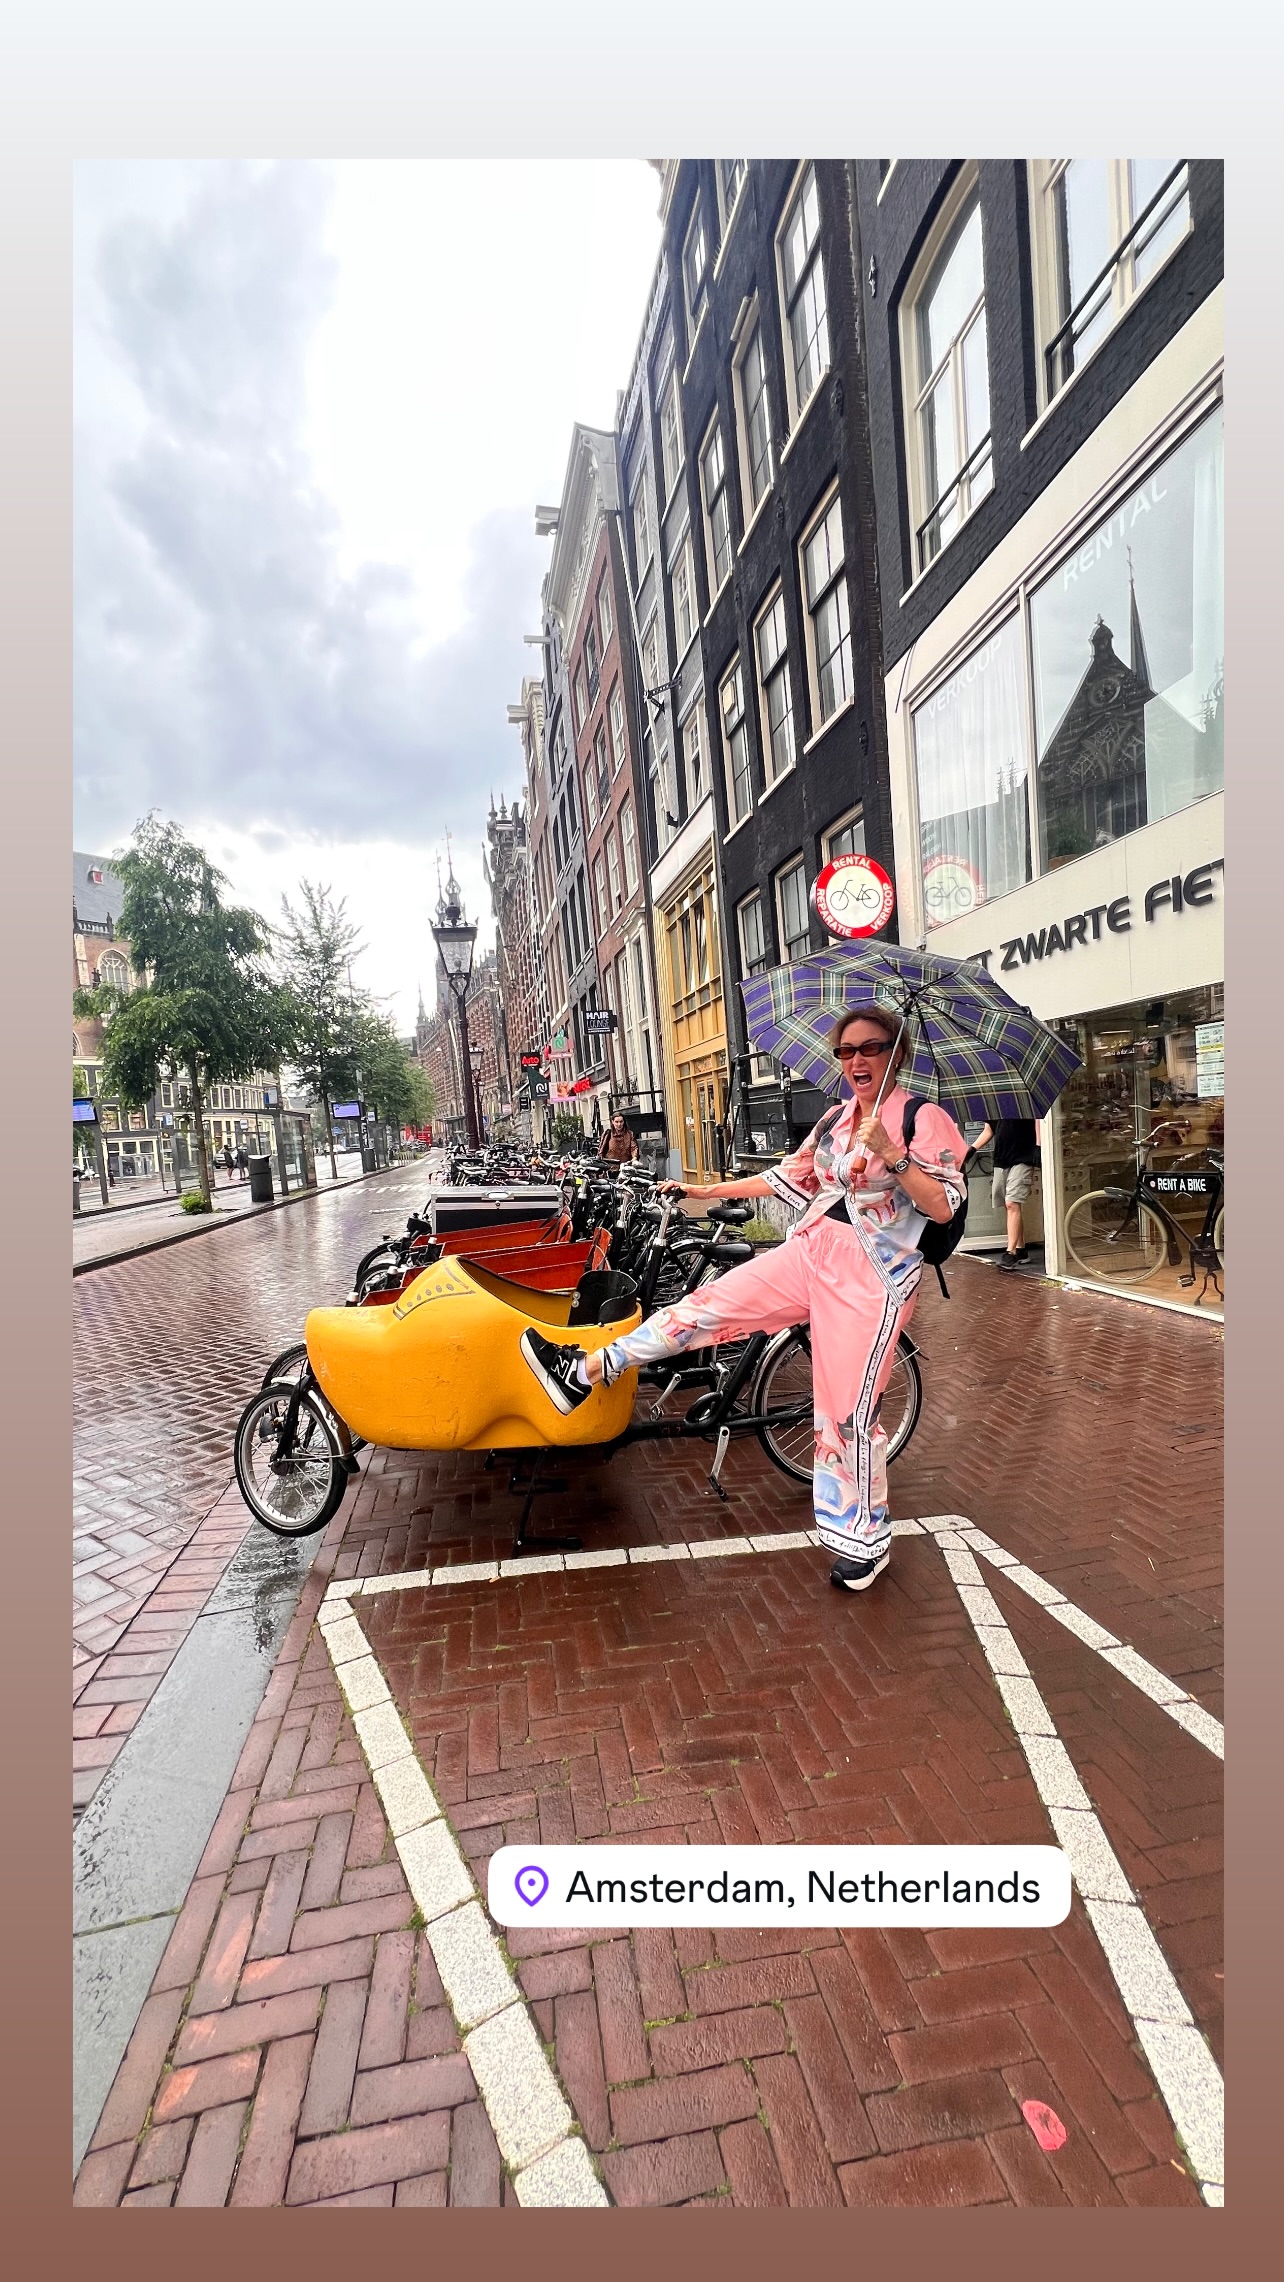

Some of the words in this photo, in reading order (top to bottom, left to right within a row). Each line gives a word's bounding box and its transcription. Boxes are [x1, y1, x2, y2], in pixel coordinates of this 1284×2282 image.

[1062, 480, 1168, 593] RENTAL
[926, 636, 1002, 720] VERKOOP
[832, 856, 871, 870] RENTAL
[817, 888, 852, 937] REPARATIE
[870, 882, 893, 931] VERKOOP
[1000, 896, 1131, 971] ZWARTE
[586, 1011, 609, 1020] HAIR
[1157, 1178, 1177, 1191] RENT
[1180, 1178, 1186, 1191] A
[1187, 1178, 1207, 1192] BIKE
